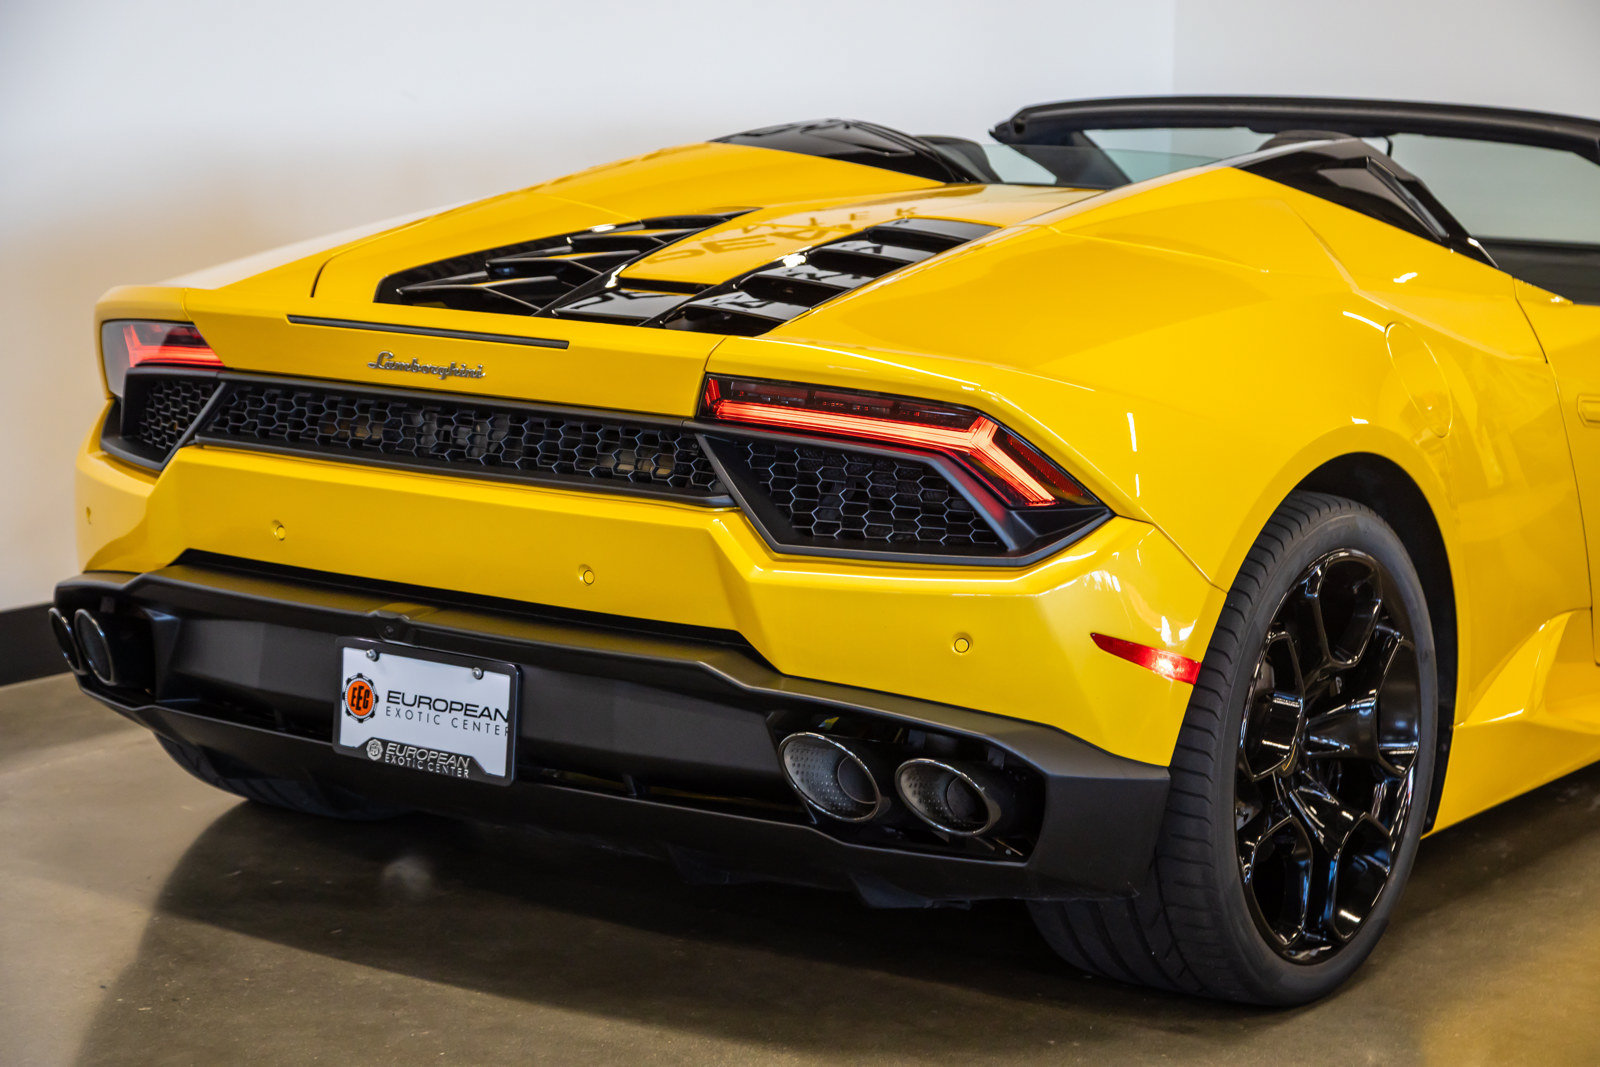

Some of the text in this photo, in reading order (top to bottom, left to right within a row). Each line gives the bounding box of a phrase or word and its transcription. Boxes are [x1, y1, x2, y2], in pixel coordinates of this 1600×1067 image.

[367, 350, 486, 380] Lamborghini
[385, 706, 441, 726] EXOTIC
[386, 689, 509, 723] EUROPEAN
[384, 753, 470, 779] EXOTIC CENTER
[385, 742, 471, 768] EUROPEAN
